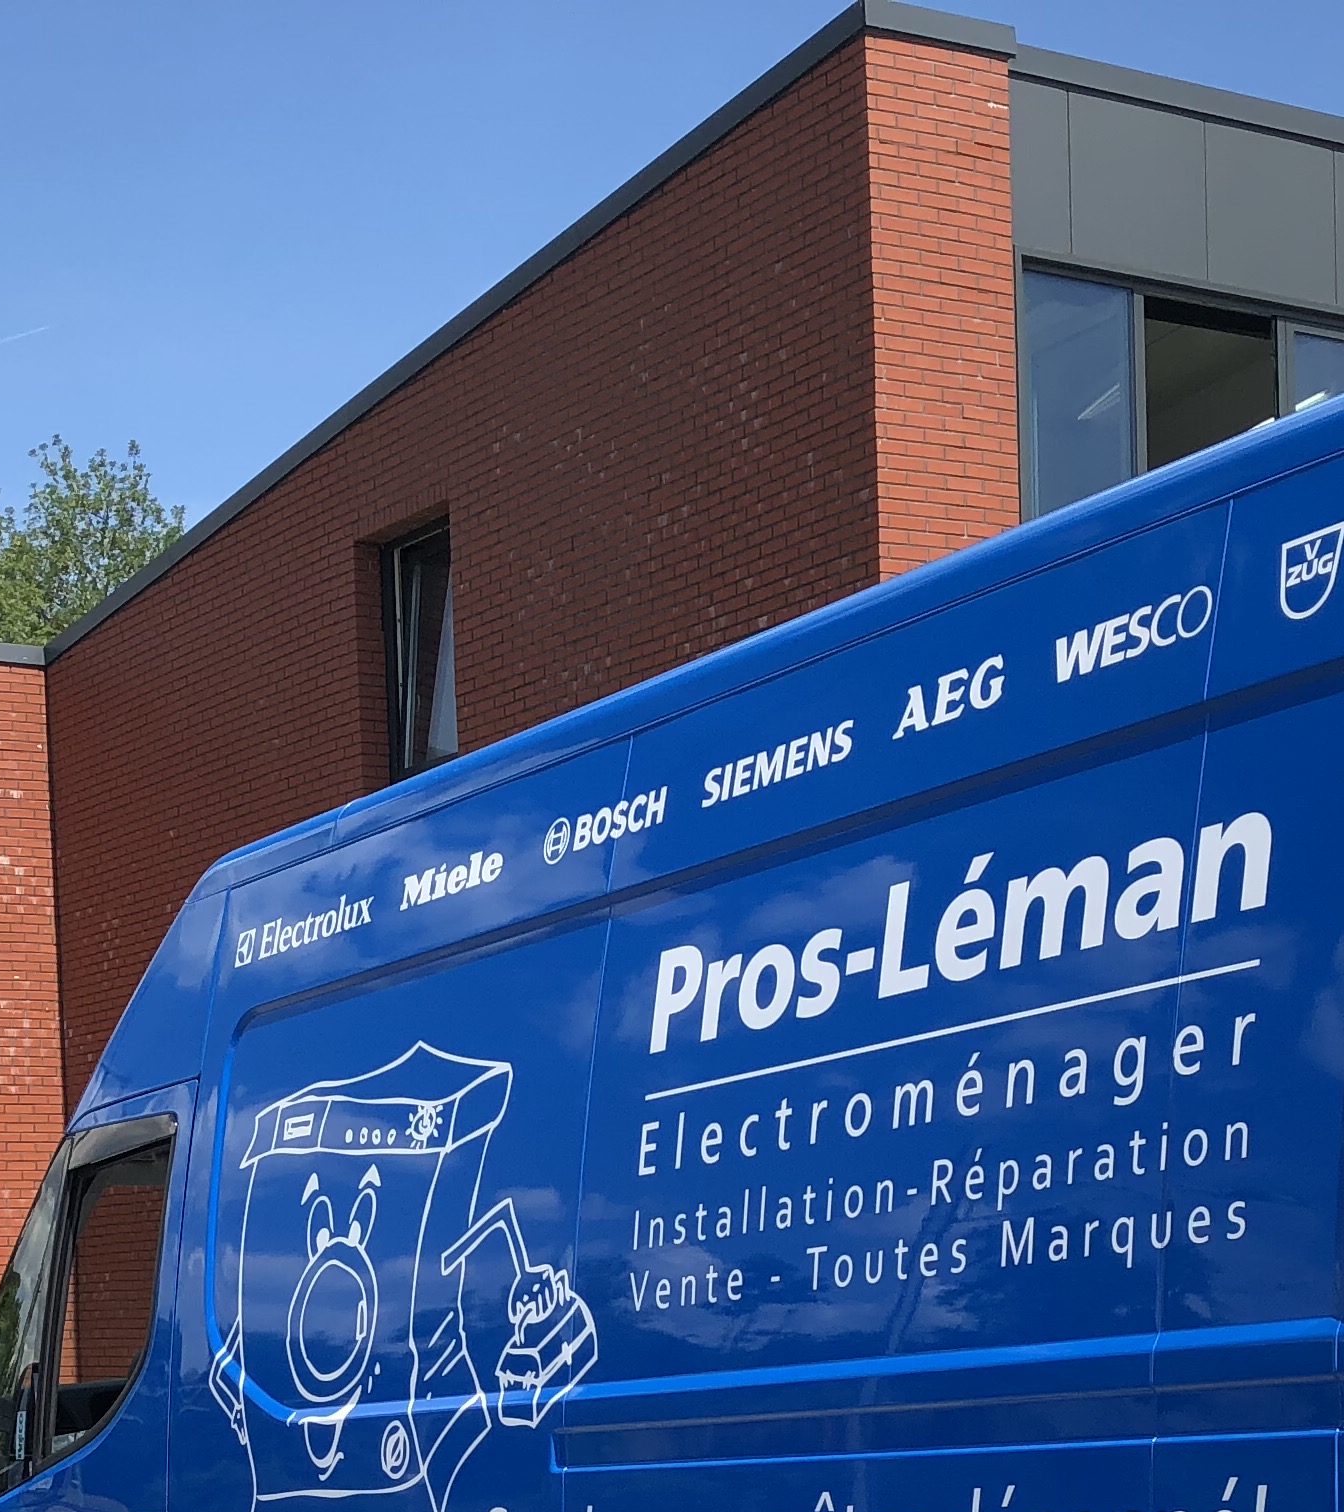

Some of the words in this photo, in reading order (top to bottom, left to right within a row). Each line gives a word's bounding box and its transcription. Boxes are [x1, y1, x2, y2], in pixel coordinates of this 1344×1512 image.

[1286, 552, 1334, 588] ZUG
[257, 894, 374, 961] Electrolux
[399, 850, 504, 911] Miele
[572, 785, 668, 852] BOSCH
[701, 719, 854, 808] SIEMENS
[892, 654, 1005, 740] AEG
[1055, 585, 1213, 684] WESCO
[649, 811, 1272, 1055] Pros-Léman
[637, 1012, 1256, 1176] Electroménager
[629, 1264, 744, 1312] Vente
[806, 1238, 967, 1291] Toutes
[999, 1200, 1246, 1268] Marques
